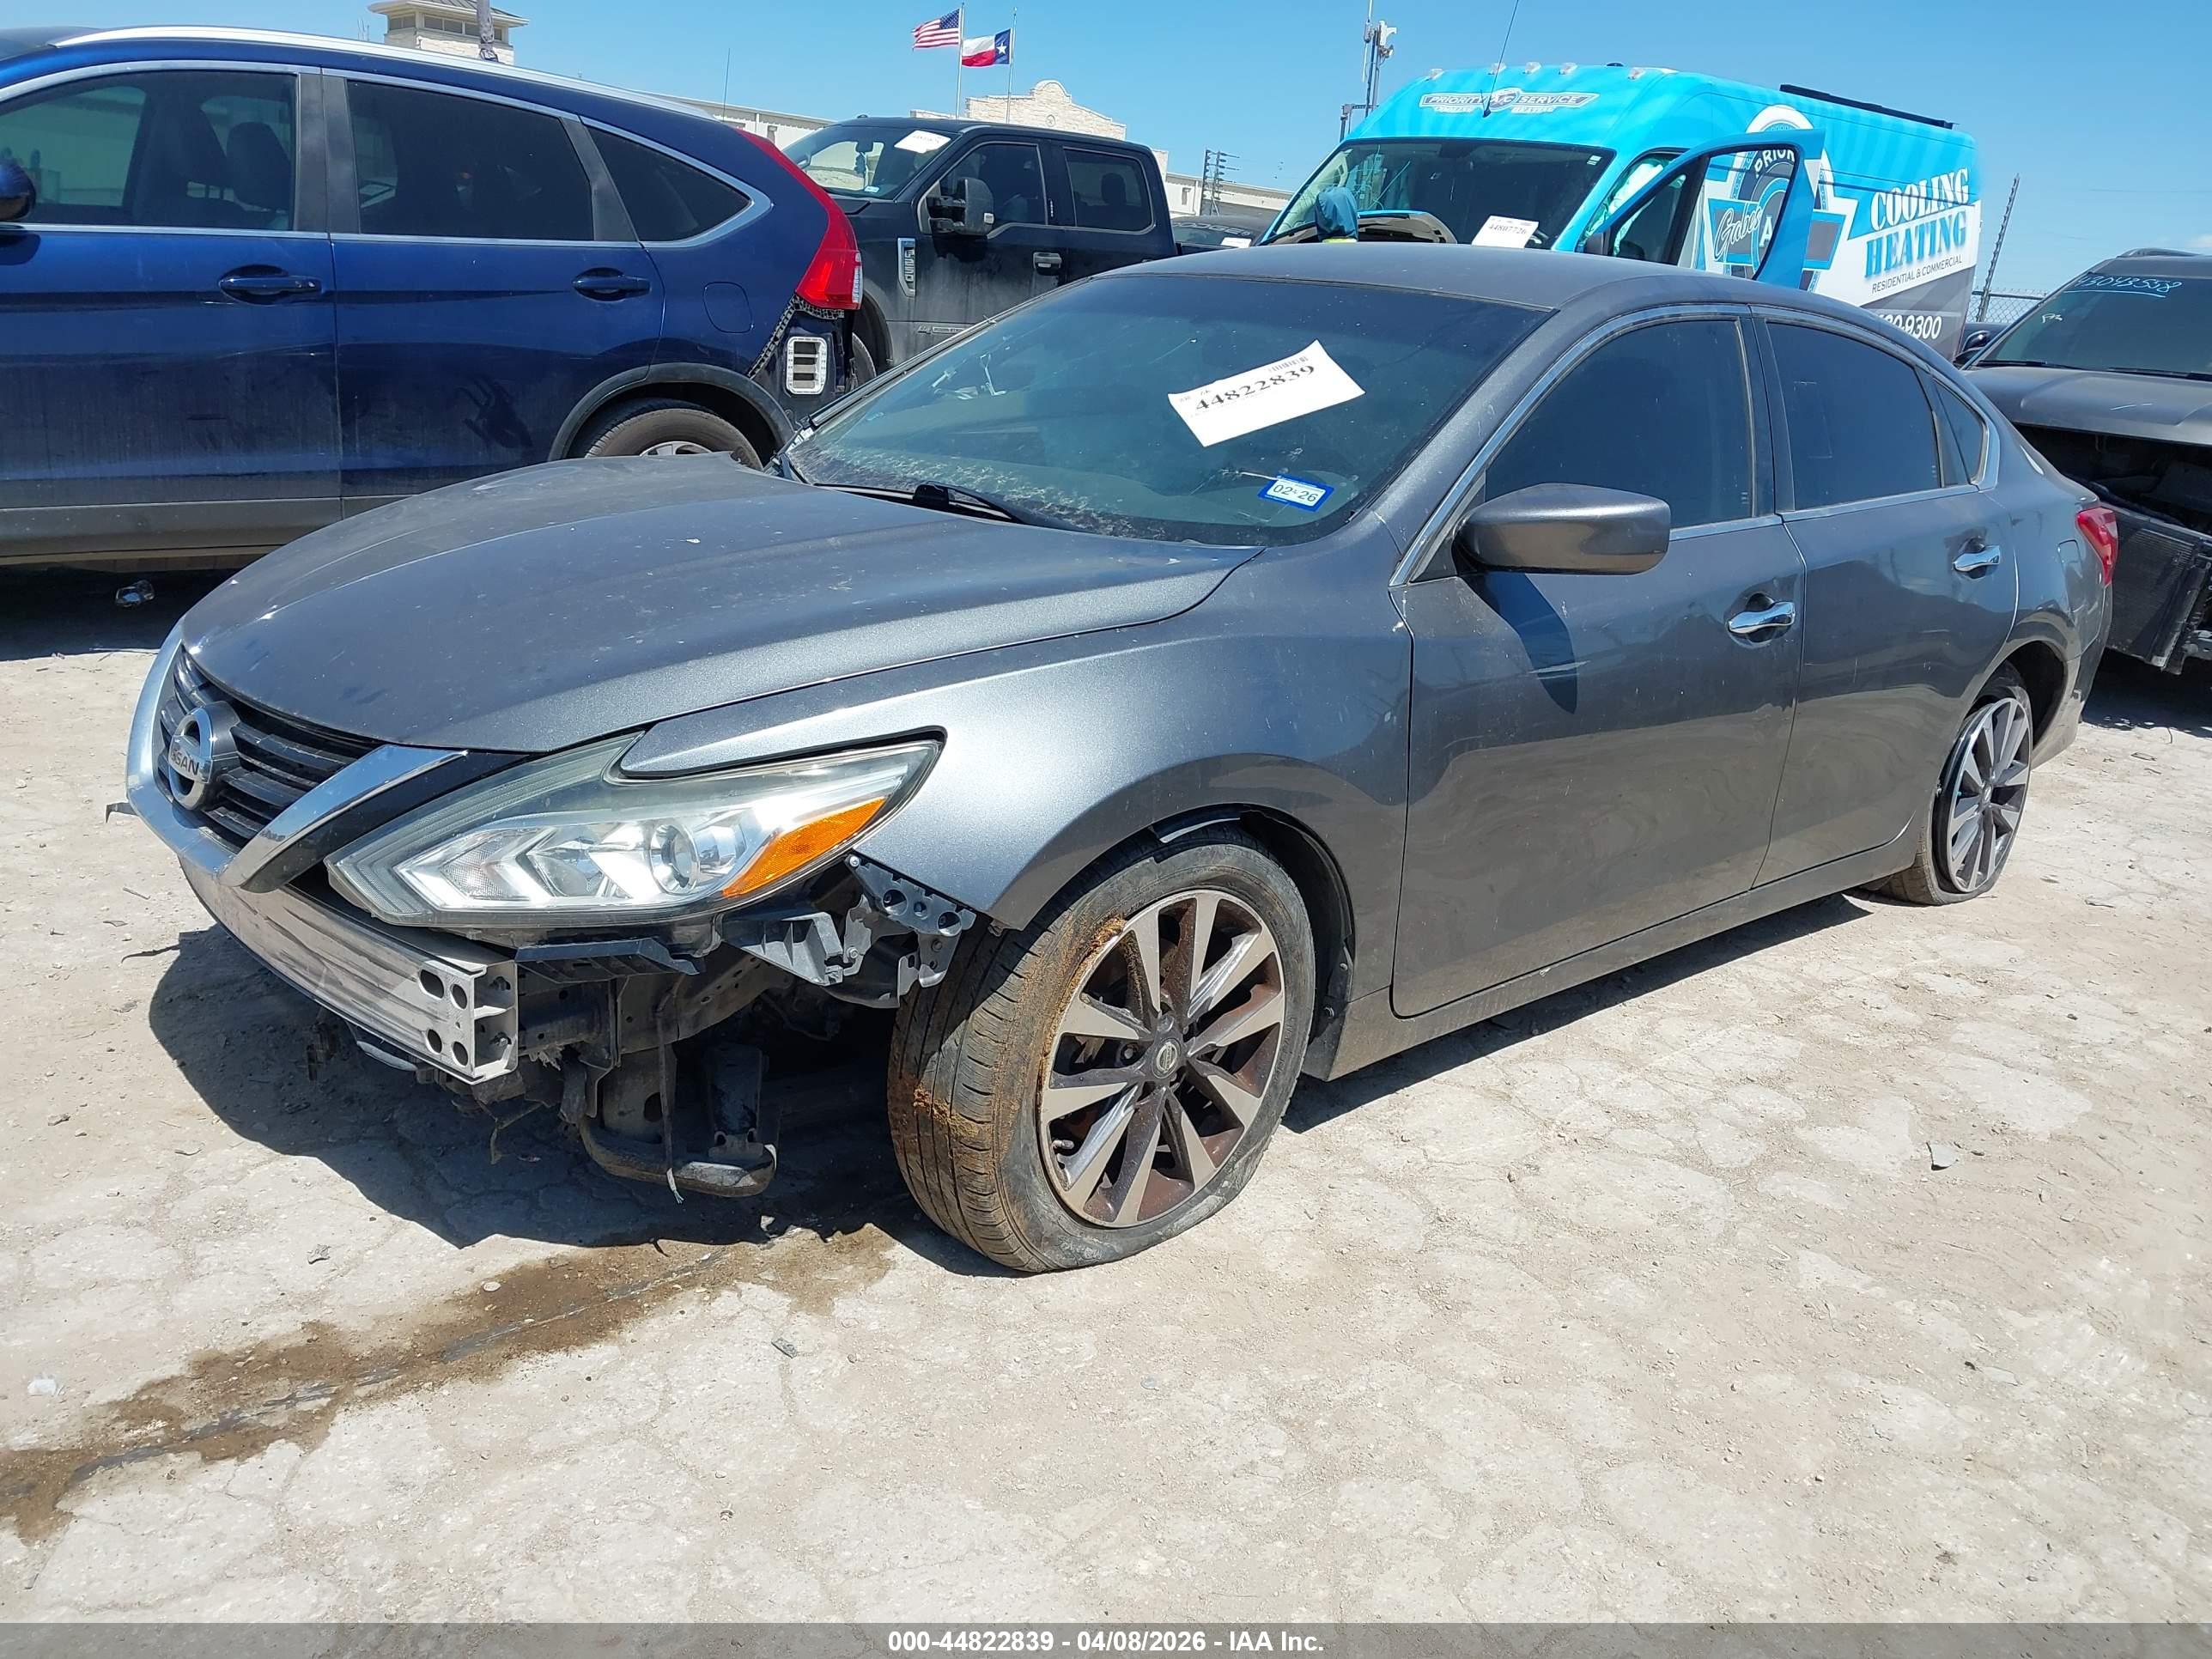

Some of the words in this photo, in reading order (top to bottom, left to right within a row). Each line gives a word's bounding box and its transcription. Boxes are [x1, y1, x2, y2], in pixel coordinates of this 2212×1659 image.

[1429, 95, 1485, 104] PRIORITY
[1519, 95, 1577, 104] SERVICE
[1870, 167, 1970, 232] COOLING
[1864, 209, 1966, 278] HEATING
[1872, 272, 1916, 295] RESIDENTIAL
[1916, 269, 1922, 279] &
[1922, 254, 1963, 276] COMMERCIAL
[1196, 364, 1316, 410] 44822839
